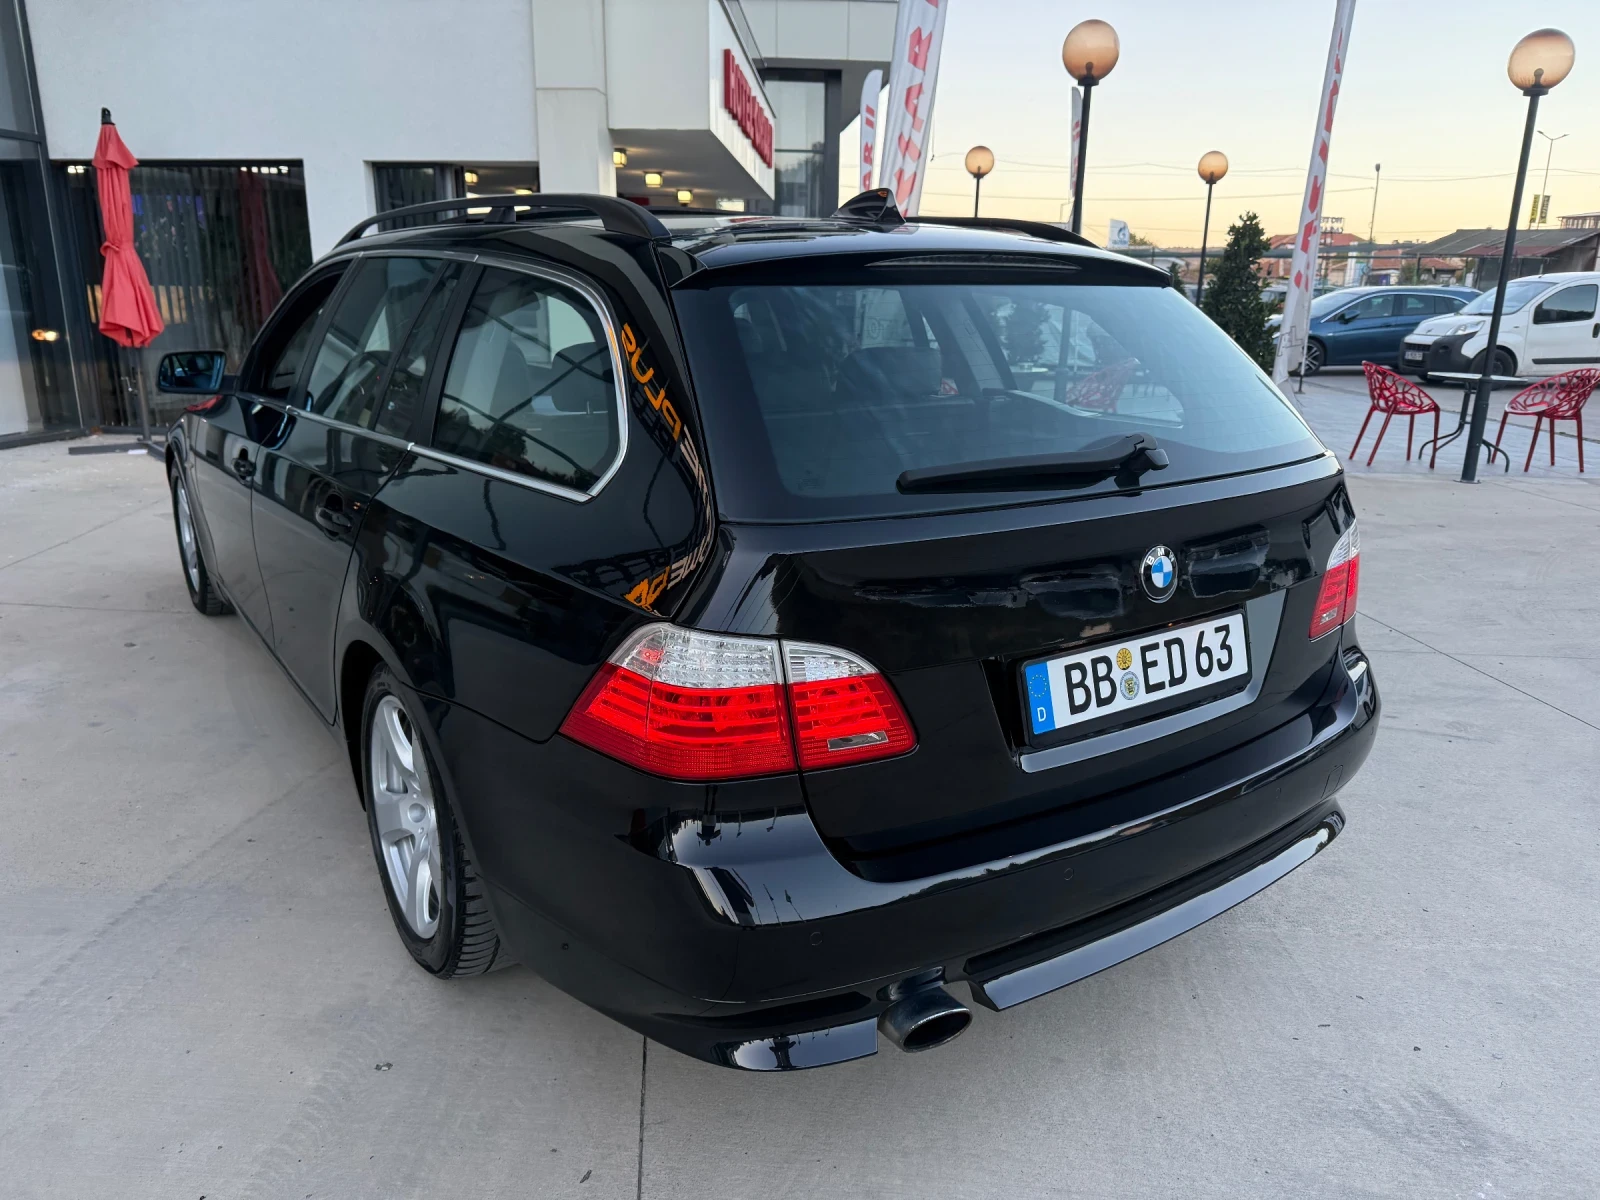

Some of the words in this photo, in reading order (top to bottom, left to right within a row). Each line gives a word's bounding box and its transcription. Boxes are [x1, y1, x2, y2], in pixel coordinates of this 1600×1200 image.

[1146, 547, 1175, 565] BMW
[1064, 655, 1118, 716] BB
[1140, 637, 1188, 695] ED
[1195, 624, 1234, 678] 63
[1037, 706, 1047, 723] D
